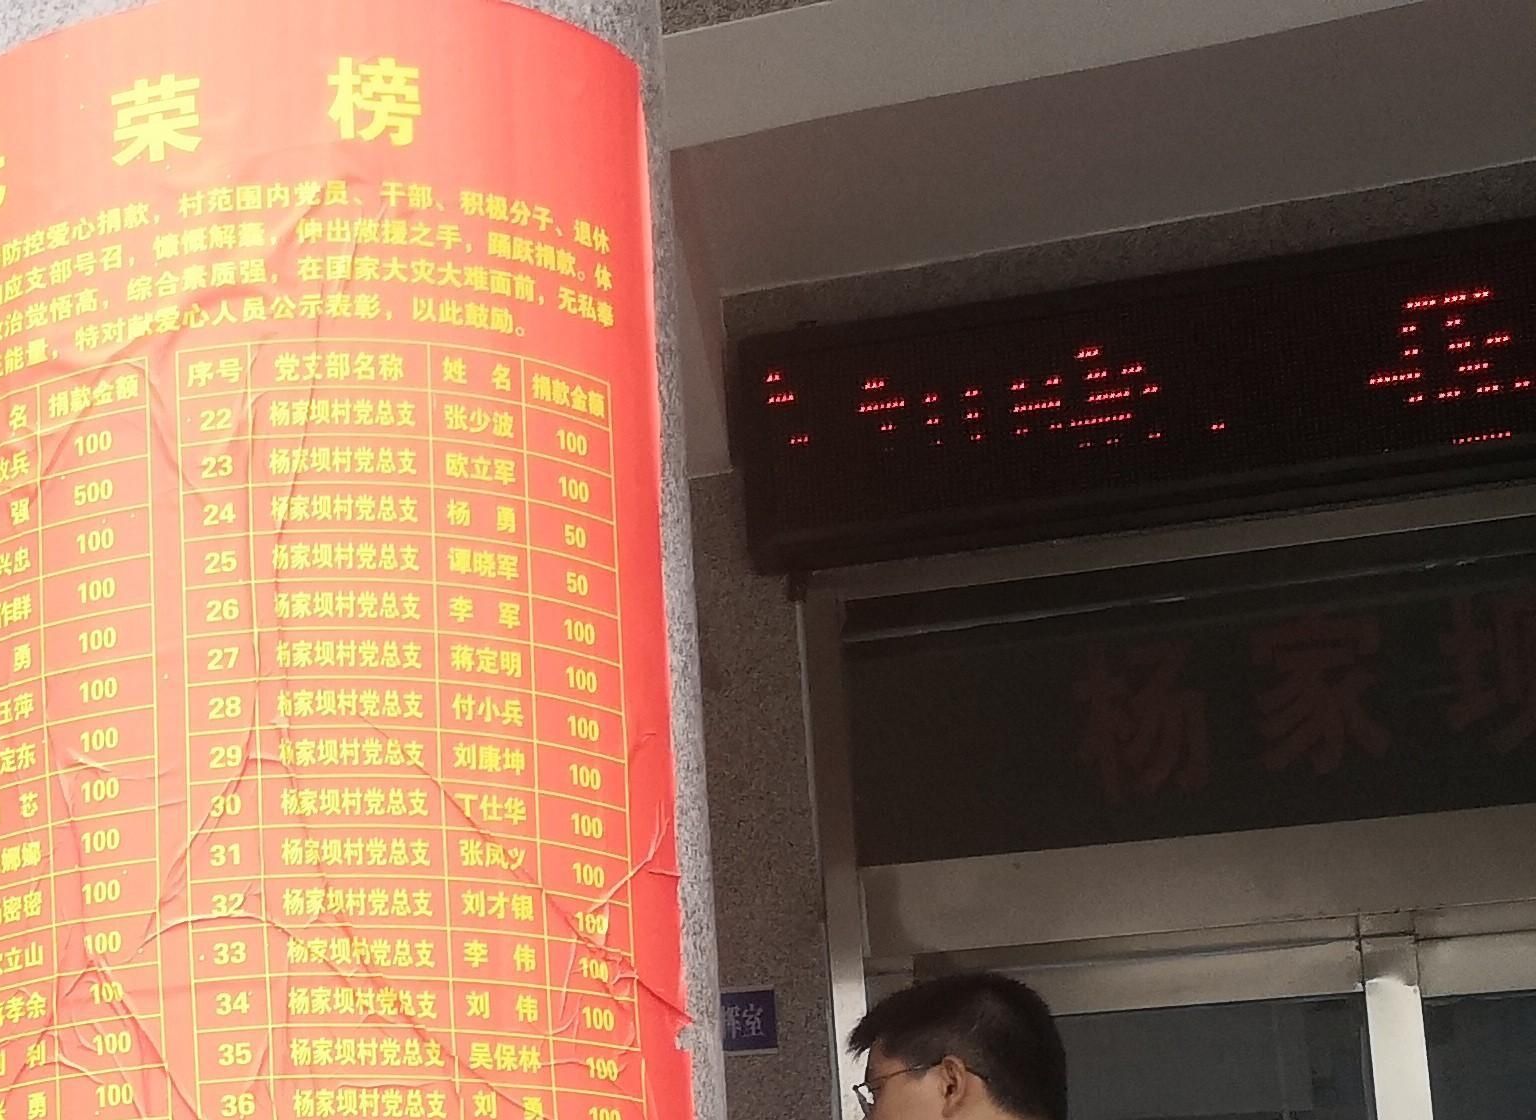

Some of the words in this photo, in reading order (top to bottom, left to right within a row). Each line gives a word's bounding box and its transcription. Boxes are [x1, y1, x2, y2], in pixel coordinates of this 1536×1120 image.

[47, 374, 140, 418] 捐款金额
[186, 358, 243, 388] 序号
[273, 351, 404, 382] 党支部名称
[530, 372, 607, 419] 捐款金额
[74, 430, 112, 456] 100
[200, 408, 232, 431] 22
[269, 399, 415, 426] 杨家坝村党总支
[444, 404, 514, 438] 张少波
[556, 429, 588, 456] 100
[74, 479, 113, 506] 500
[201, 455, 233, 479] 23
[445, 452, 516, 485] 欧立军
[558, 475, 590, 503] 100
[76, 527, 114, 554] 100
[203, 502, 236, 526] 24
[564, 523, 587, 549] 50
[204, 550, 237, 574] 25
[566, 571, 589, 596] 50
[77, 577, 116, 604] 100
[206, 598, 239, 622] 26
[563, 618, 596, 645] 100
[78, 626, 117, 653] 100
[207, 647, 239, 671] 27
[565, 665, 598, 694] 100
[79, 676, 118, 703] 100
[208, 695, 242, 720] 28
[452, 693, 524, 727] 付小兵
[567, 715, 600, 742] 100
[80, 727, 119, 753] 100
[209, 744, 242, 769] 29
[569, 763, 602, 791] 100
[81, 777, 120, 803] 100
[210, 794, 242, 817] 30
[280, 787, 429, 817] 杨家坝村党总支
[454, 793, 527, 825] 丁仕华
[570, 812, 604, 839] 100
[81, 828, 120, 854] 100
[210, 843, 241, 867] 31
[281, 837, 431, 866] 杨家坝村党总支
[572, 861, 605, 889] 100
[82, 879, 121, 905] 100
[210, 892, 245, 917] 32
[282, 887, 433, 917] 杨家坝村党总支
[461, 889, 534, 921] 刘才银
[83, 930, 122, 955] 100
[213, 941, 246, 965] 33
[216, 991, 250, 1016] 34
[582, 1006, 615, 1032] 100
[92, 1030, 132, 1056] 100
[218, 1042, 252, 1066] 35
[290, 1037, 445, 1067] 杨家坝村党总支
[469, 1042, 543, 1074] 吴保林
[95, 1082, 134, 1108] 100
[221, 1093, 256, 1120] 36
[292, 1088, 447, 1119] 杨家坝村党总支
